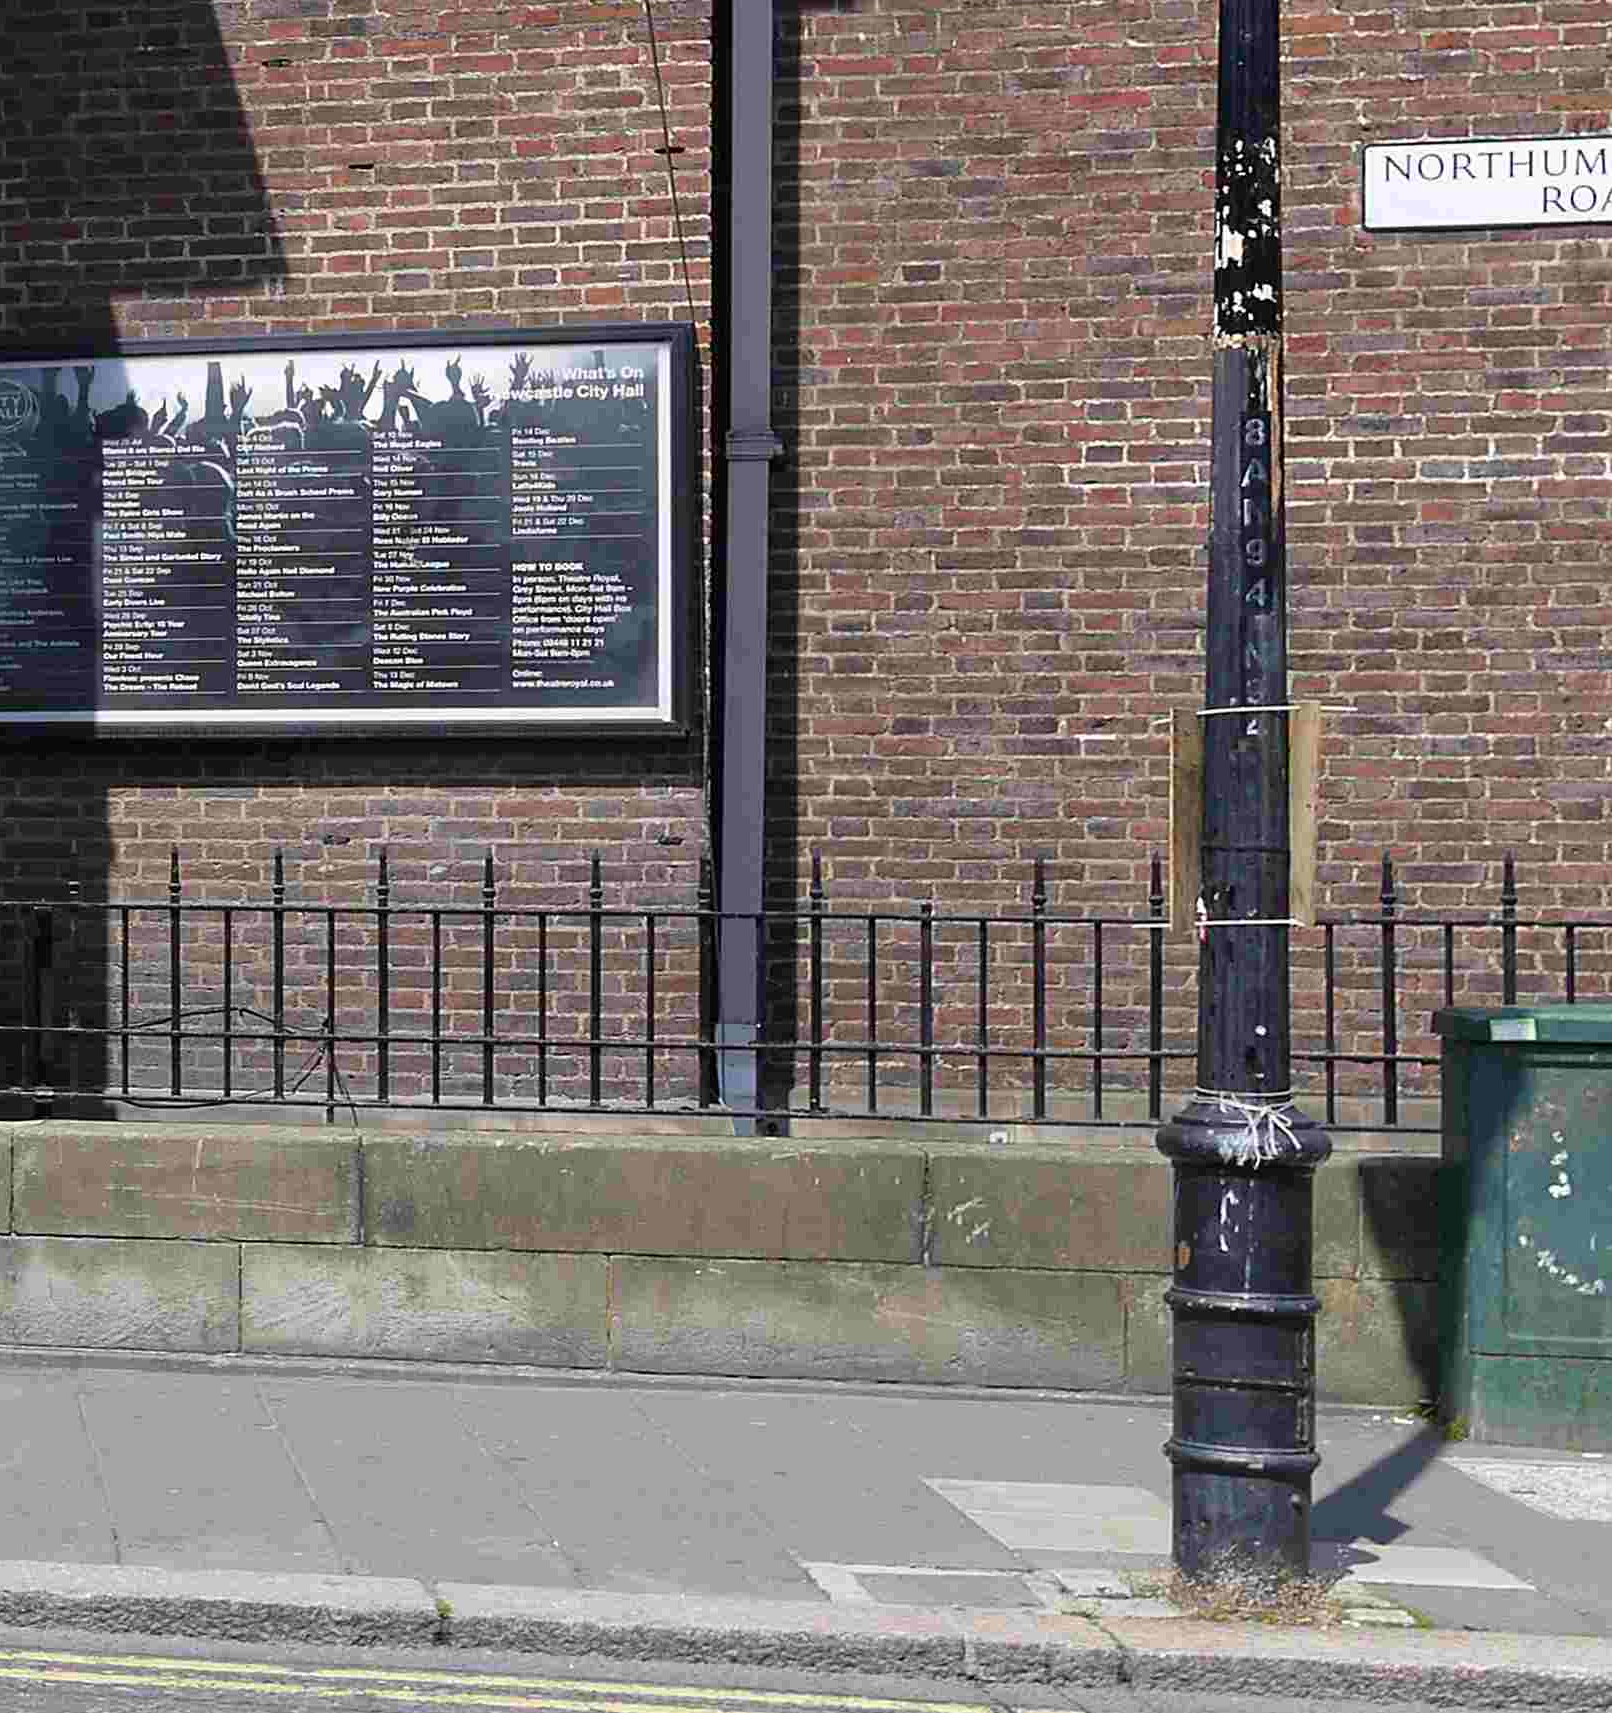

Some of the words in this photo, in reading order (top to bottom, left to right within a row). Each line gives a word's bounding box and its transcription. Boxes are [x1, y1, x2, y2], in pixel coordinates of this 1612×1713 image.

[1384, 148, 1607, 182] NORTHUM
[565, 367, 616, 381] What's
[621, 366, 644, 379] On
[576, 384, 609, 400] City
[612, 383, 645, 398] Hall
